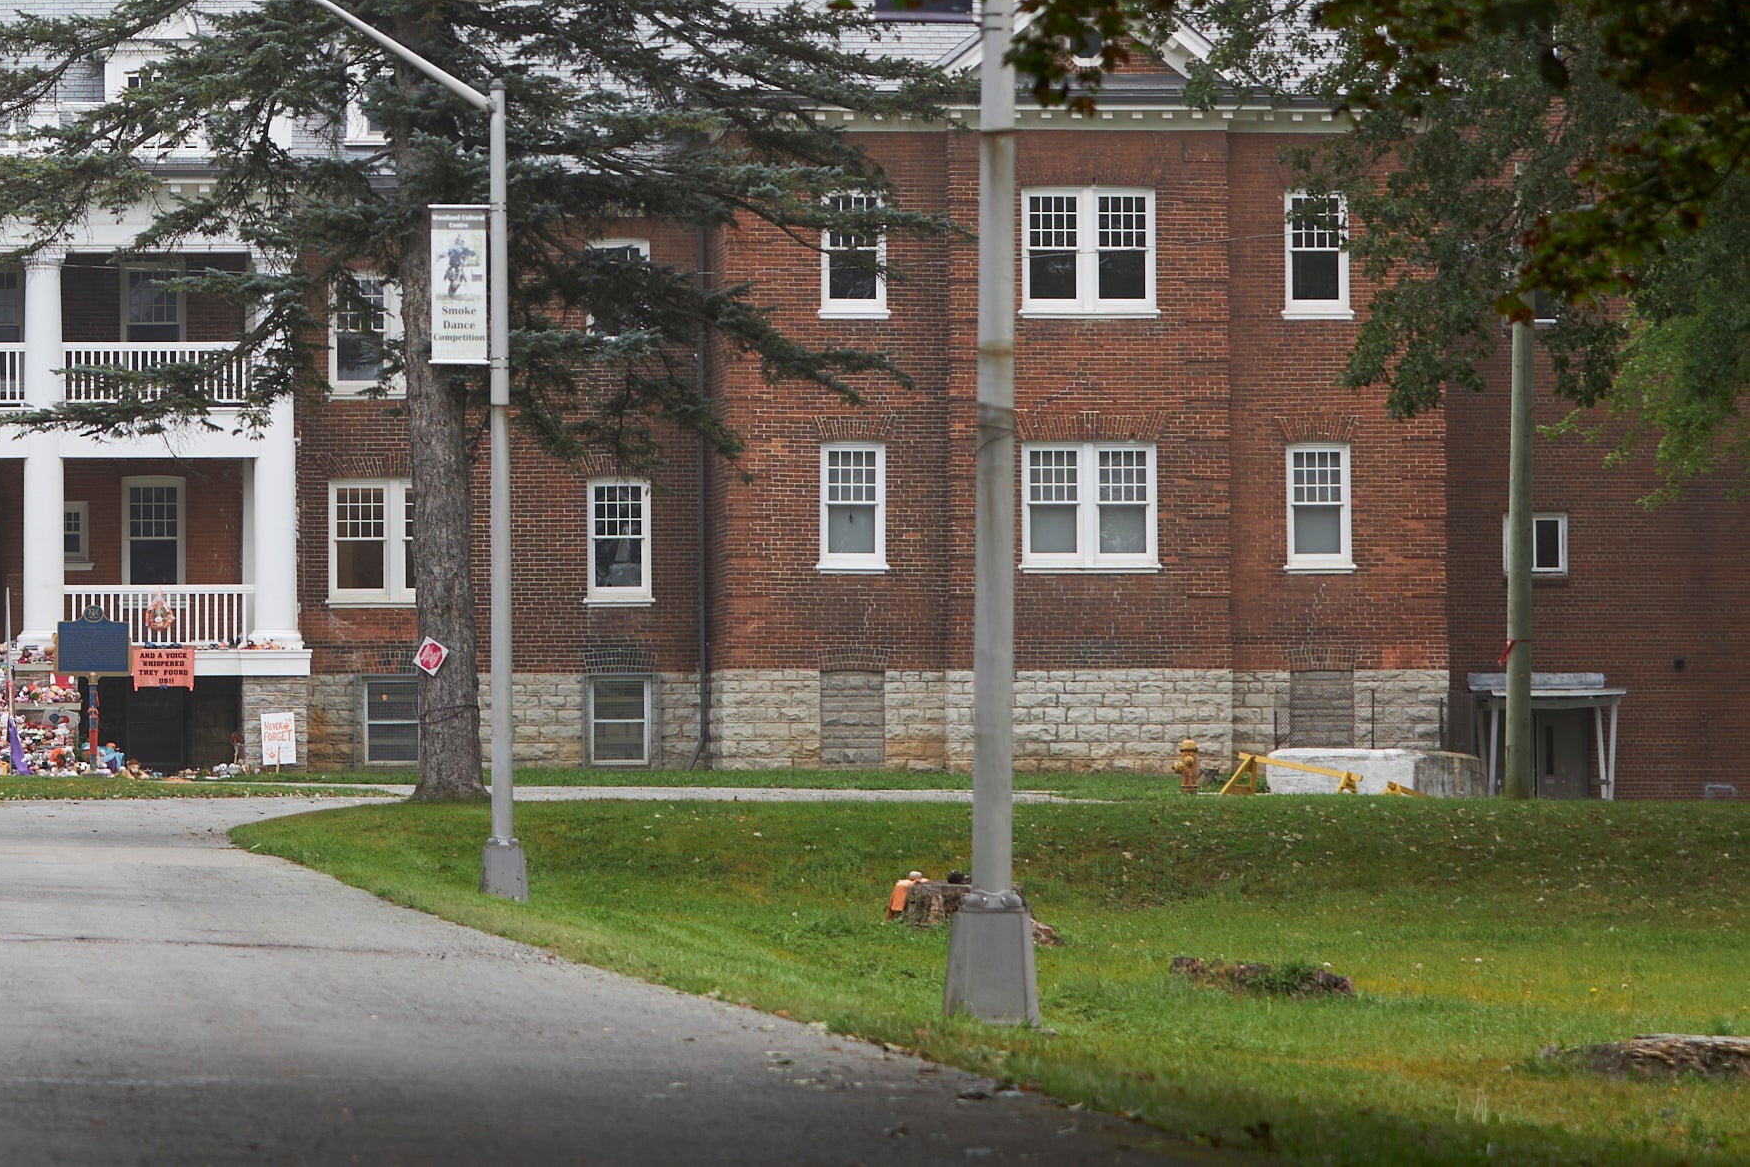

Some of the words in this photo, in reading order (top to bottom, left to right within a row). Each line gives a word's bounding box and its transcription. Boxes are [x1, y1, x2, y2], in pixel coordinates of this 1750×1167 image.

[441, 305, 477, 315] Smoke
[443, 320, 476, 329] Dance
[433, 334, 486, 342] Competition
[263, 729, 293, 742] FORGET
